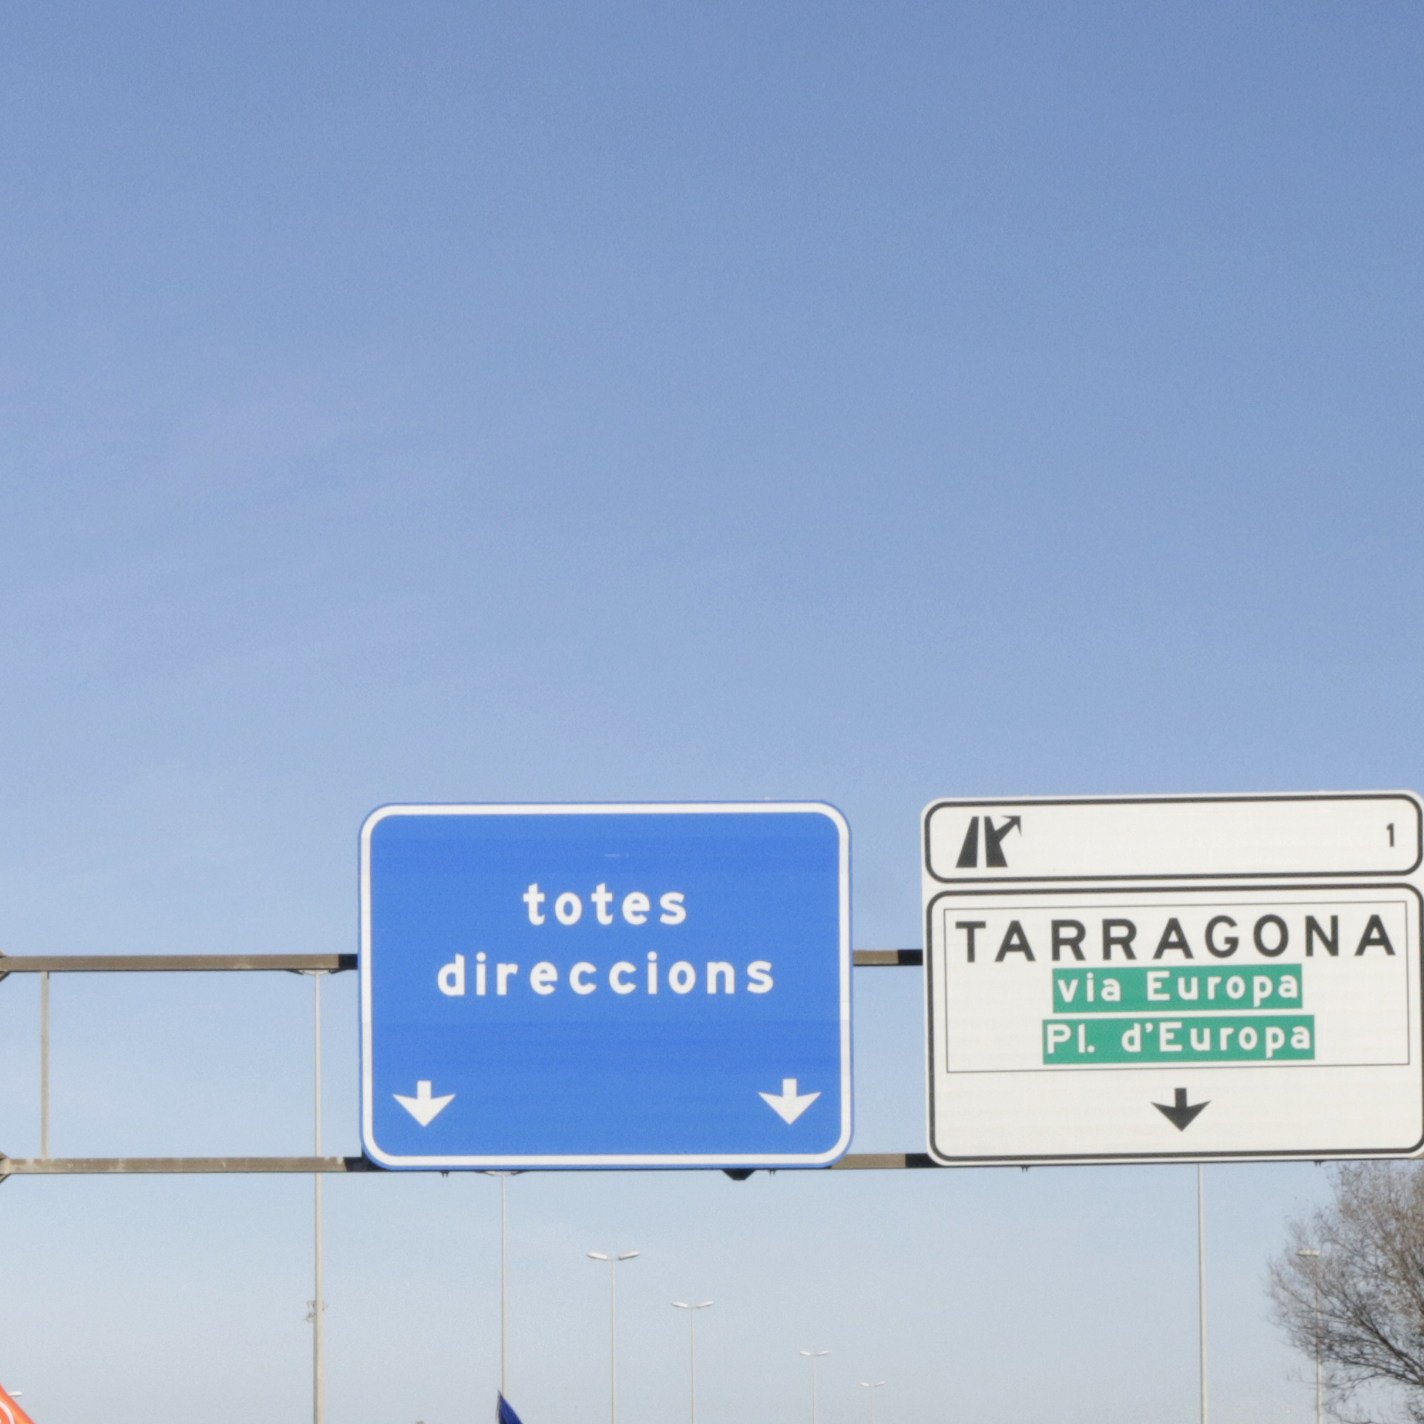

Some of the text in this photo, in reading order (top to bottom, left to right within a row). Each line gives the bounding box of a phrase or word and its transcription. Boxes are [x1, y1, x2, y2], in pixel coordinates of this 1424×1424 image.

[1385, 822, 1396, 848] 1
[522, 882, 688, 926] totes
[955, 913, 1396, 963] TARRAGONA
[436, 950, 775, 997] direccions
[1056, 971, 1300, 1007] via Europa
[1046, 1021, 1312, 1059] Pl. d'Europa
